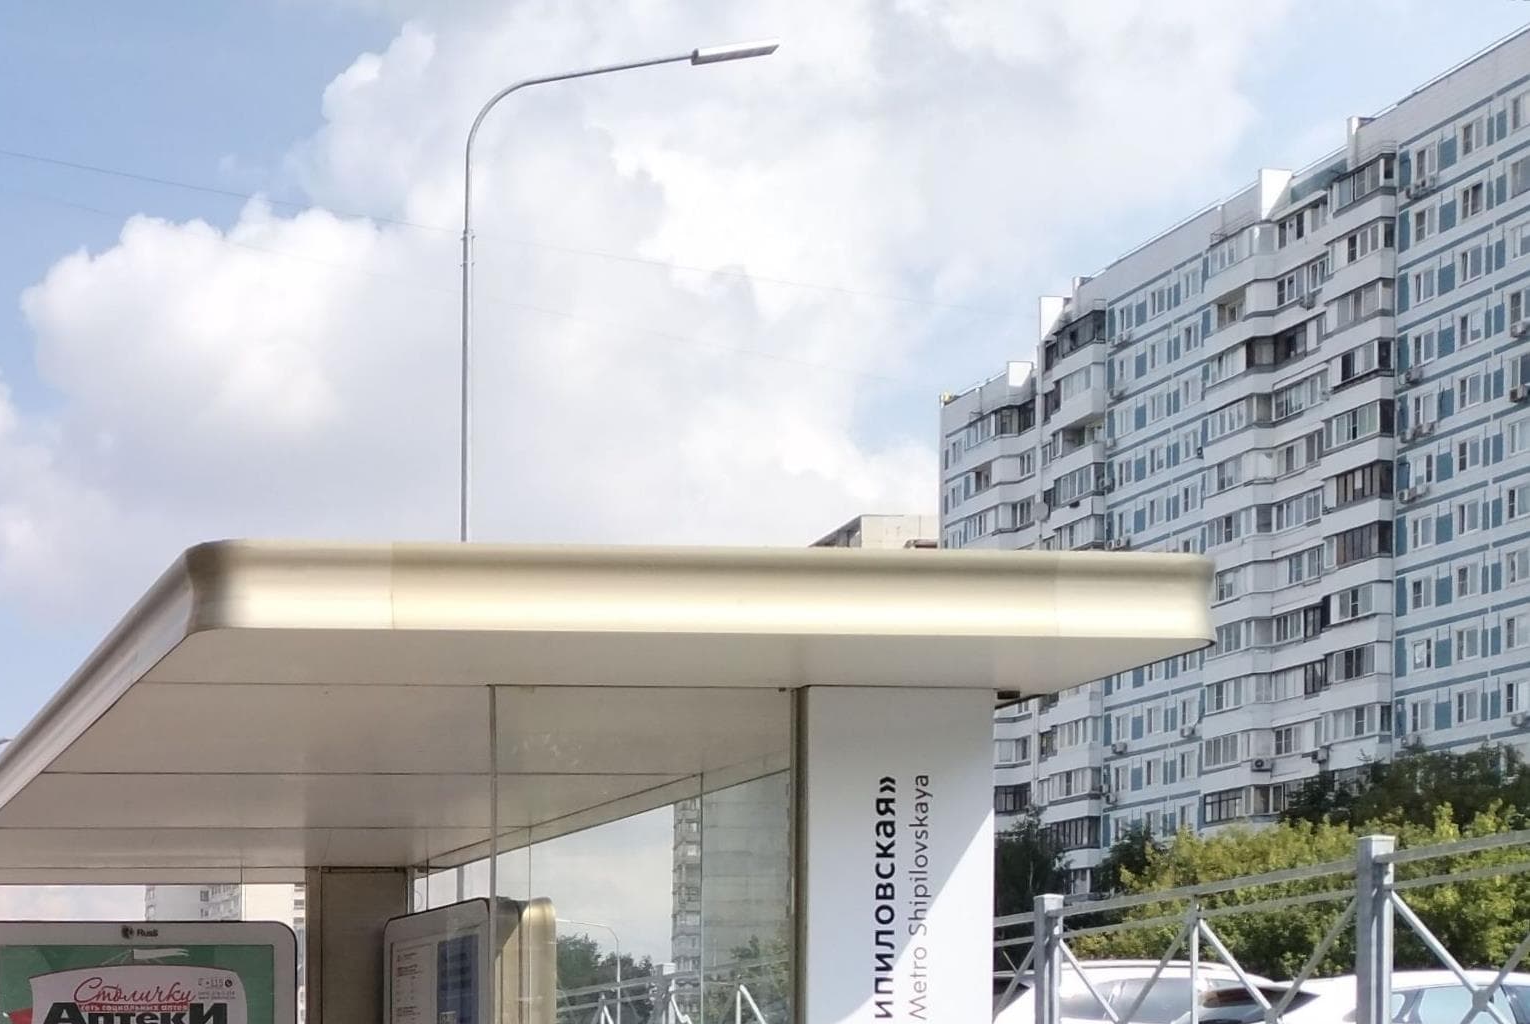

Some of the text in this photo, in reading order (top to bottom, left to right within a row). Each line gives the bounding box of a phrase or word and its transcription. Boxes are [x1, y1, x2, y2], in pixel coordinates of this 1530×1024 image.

[908, 774, 933, 1020] Metro Shipilovskaya
[74, 977, 196, 1004] Столички
